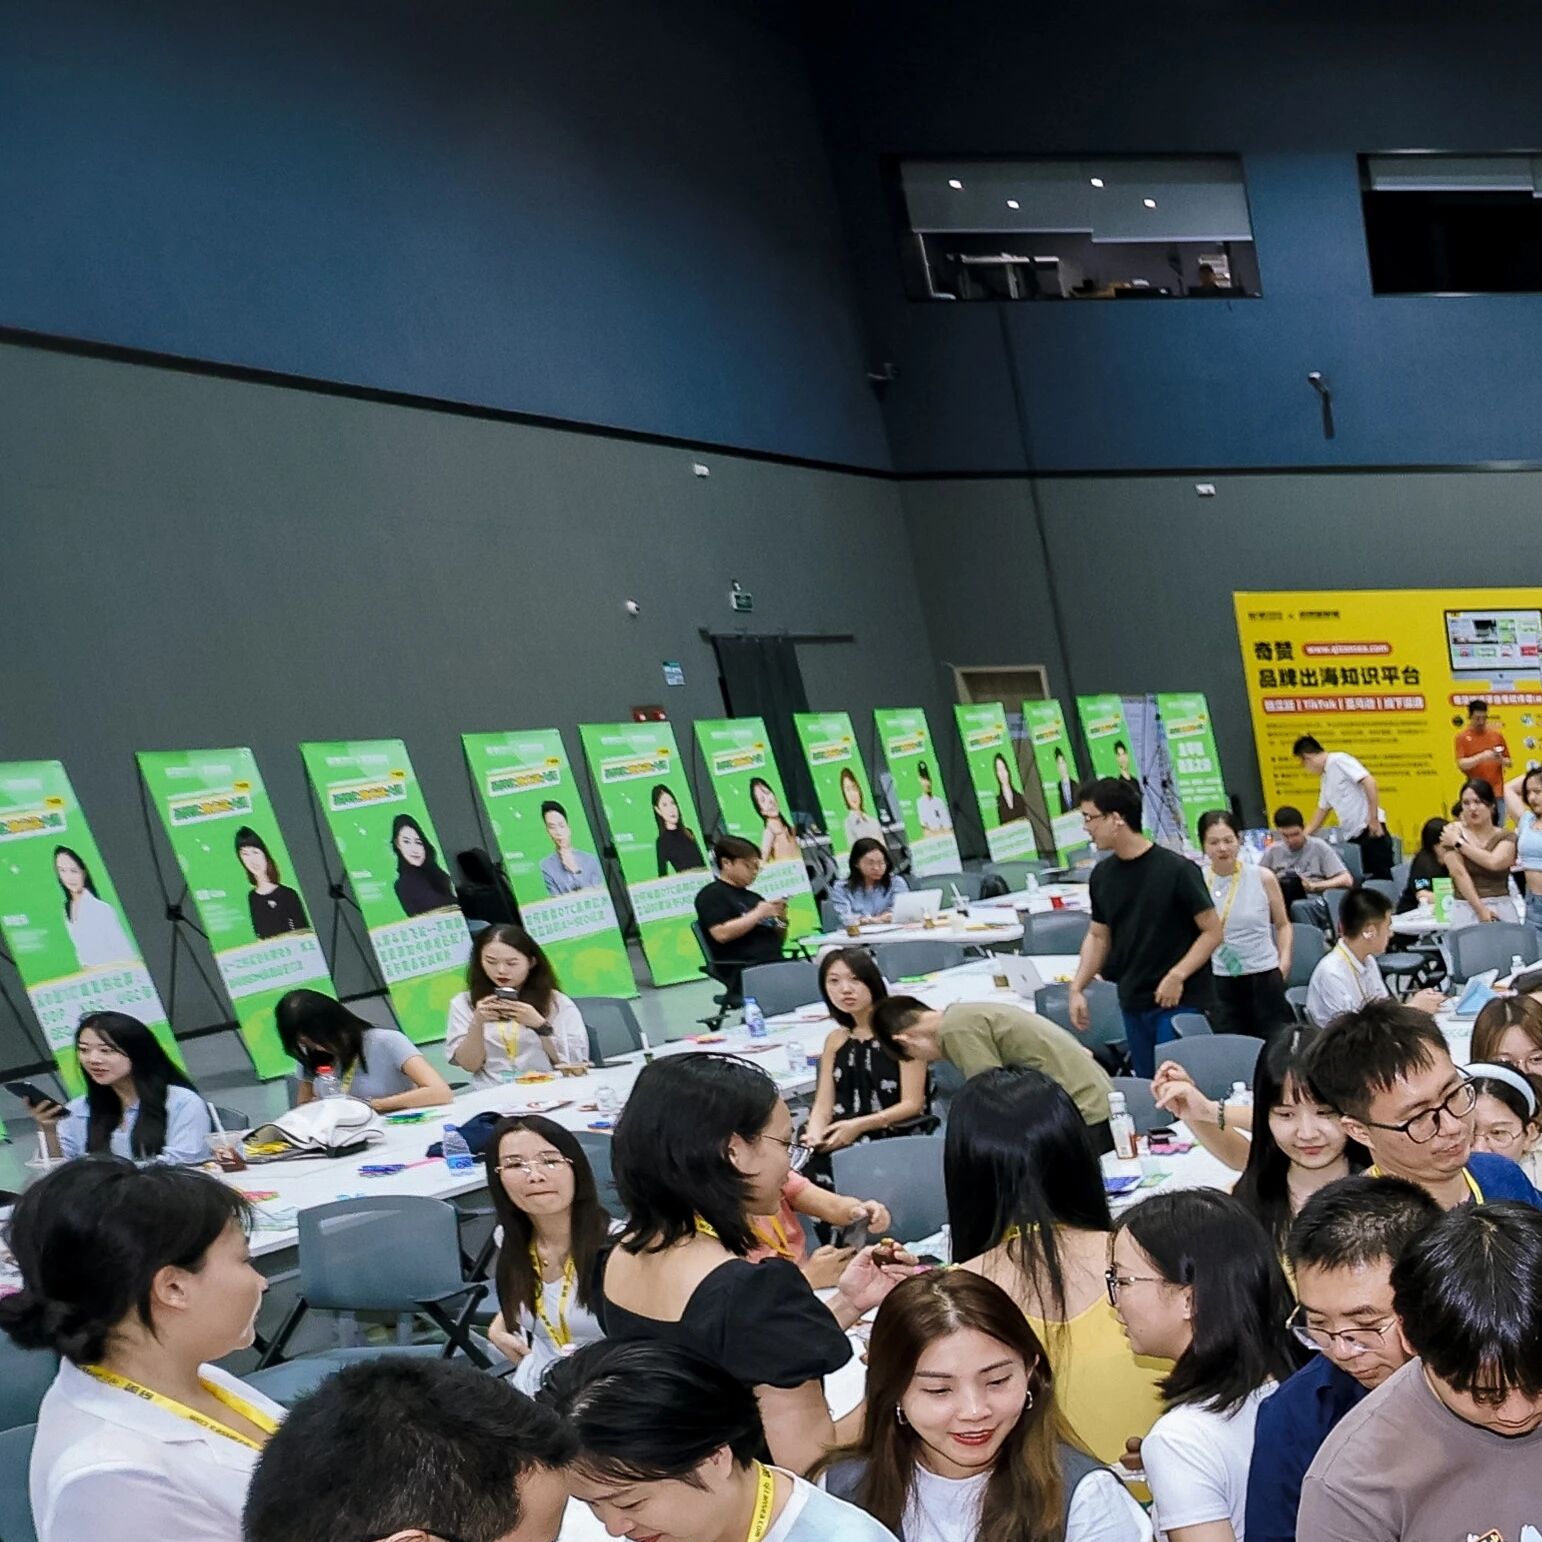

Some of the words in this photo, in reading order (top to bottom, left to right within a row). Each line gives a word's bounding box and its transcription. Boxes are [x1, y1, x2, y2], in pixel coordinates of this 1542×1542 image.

[1254, 641, 1294, 661] 奇赞
[1259, 666, 1421, 688] 品牌出海知识平台
